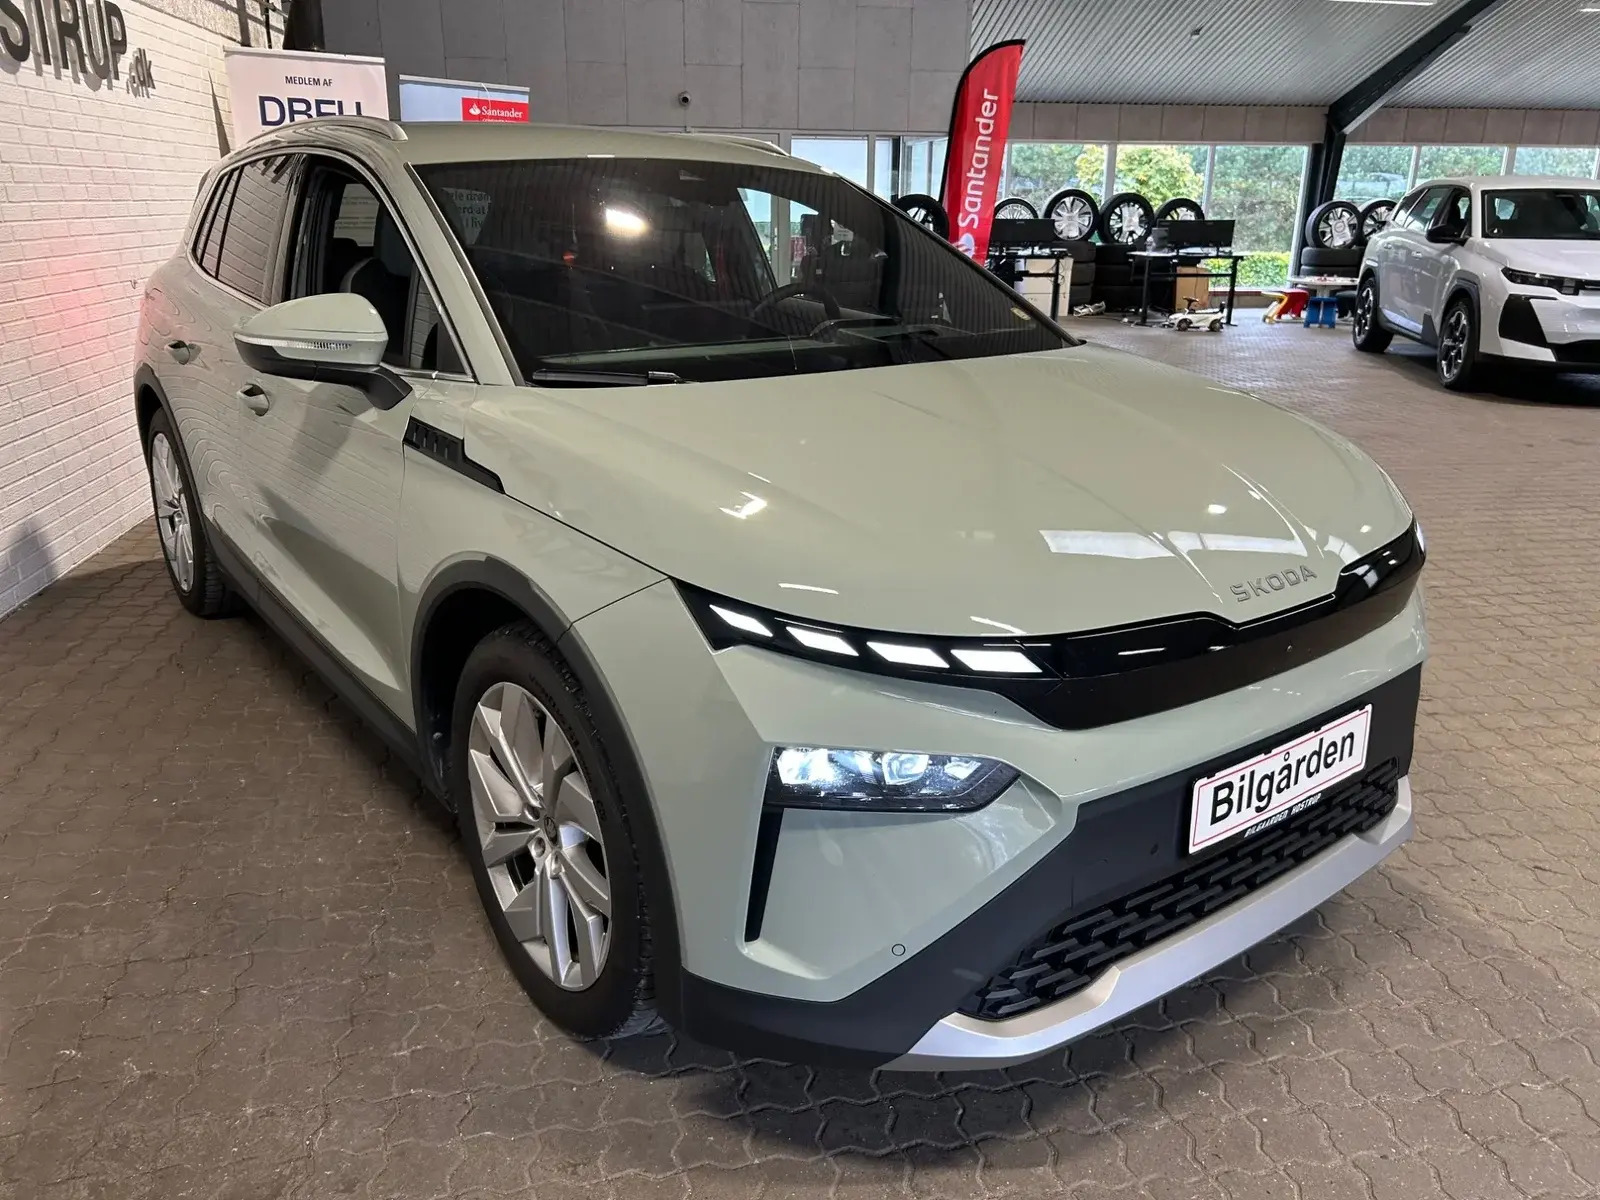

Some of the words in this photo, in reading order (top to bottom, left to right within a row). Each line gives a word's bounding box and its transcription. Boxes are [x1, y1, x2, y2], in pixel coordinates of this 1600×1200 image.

[285, 75, 321, 87] MEDLEM
[323, 78, 333, 87] AF
[481, 105, 523, 118] Santander
[957, 88, 999, 229] Santander
[1209, 731, 1355, 826] Bilgården
